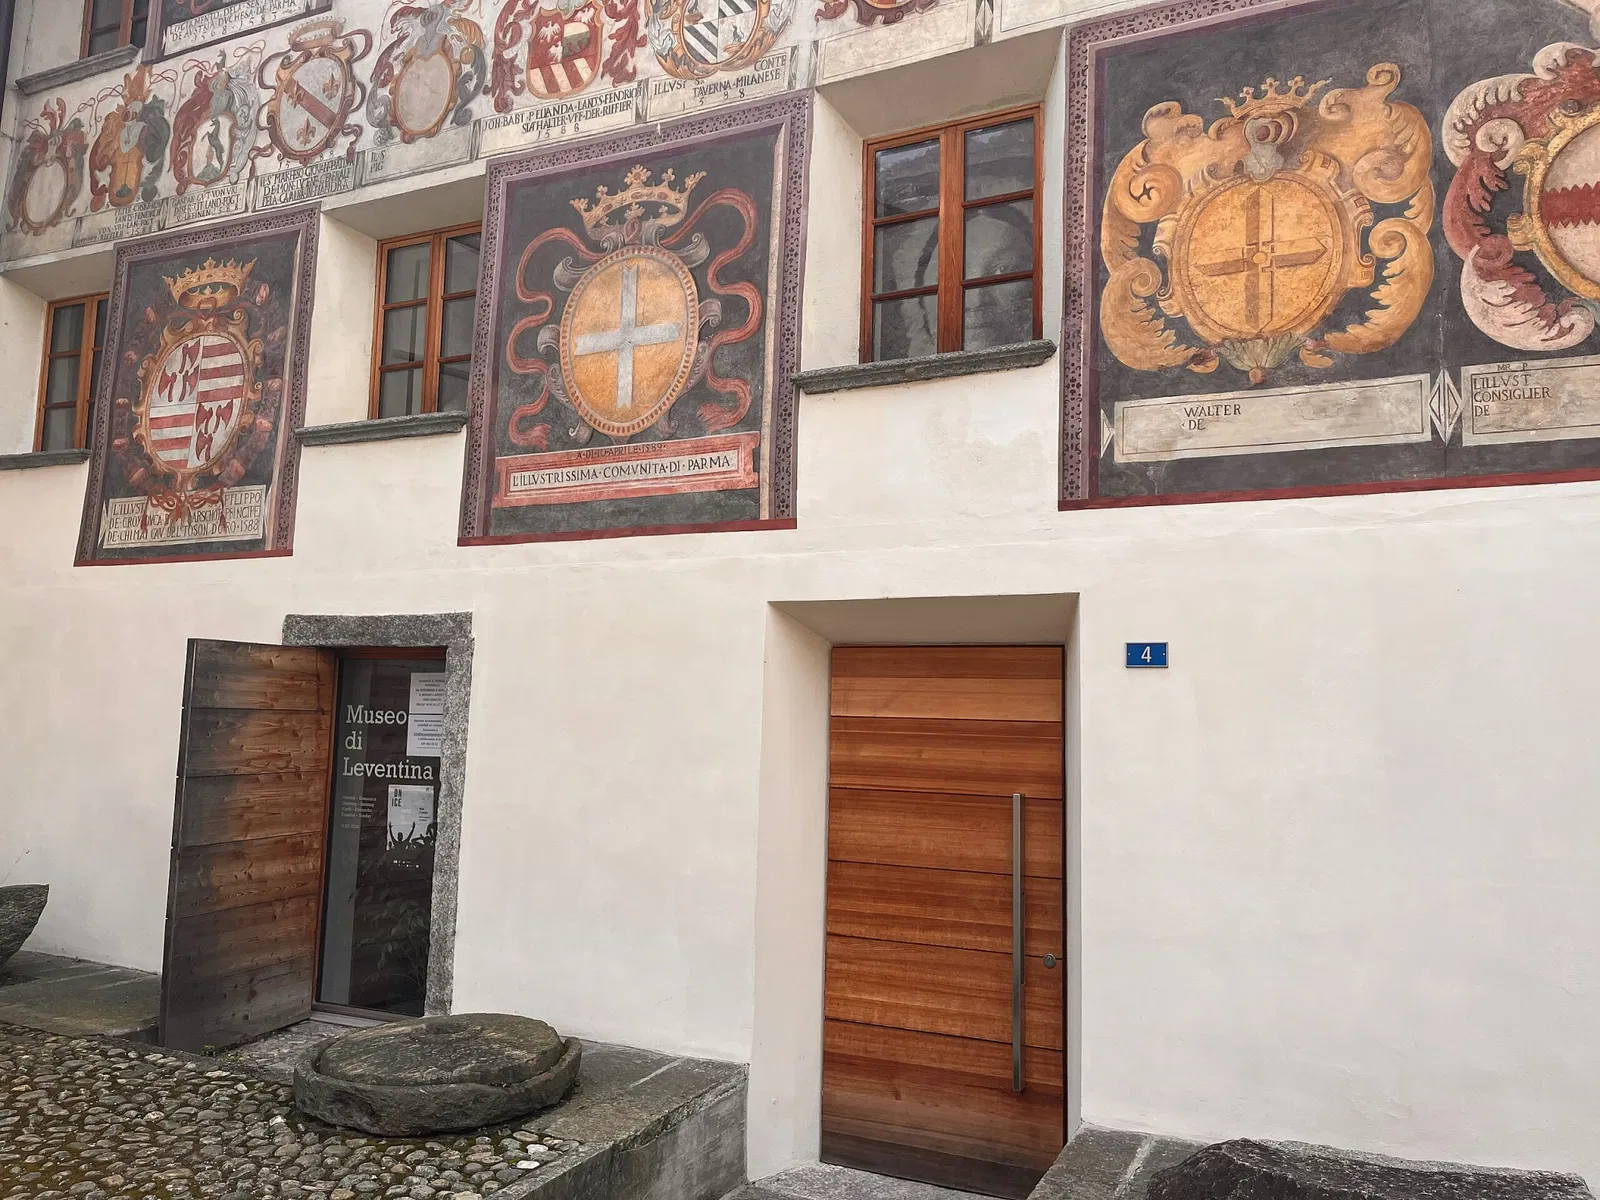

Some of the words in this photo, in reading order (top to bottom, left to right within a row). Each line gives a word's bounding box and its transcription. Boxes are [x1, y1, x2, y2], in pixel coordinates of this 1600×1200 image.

[753, 55, 787, 72] CONTE
[692, 80, 732, 98] TAVERNA
[735, 69, 781, 88] MILANESE
[584, 106, 601, 120] DER
[1473, 386, 1552, 403] CONSIGLIER
[1183, 404, 1242, 418] WALTER
[1474, 405, 1490, 417] DE
[1188, 419, 1206, 431] DE
[607, 445, 640, 457] APRILE
[668, 461, 681, 473] DI
[687, 455, 731, 471] PARMA
[224, 492, 261, 507] FILIPPO
[1141, 646, 1152, 663] 4
[345, 704, 408, 725] Museo
[344, 730, 363, 750] di
[342, 756, 434, 780] Leventina
